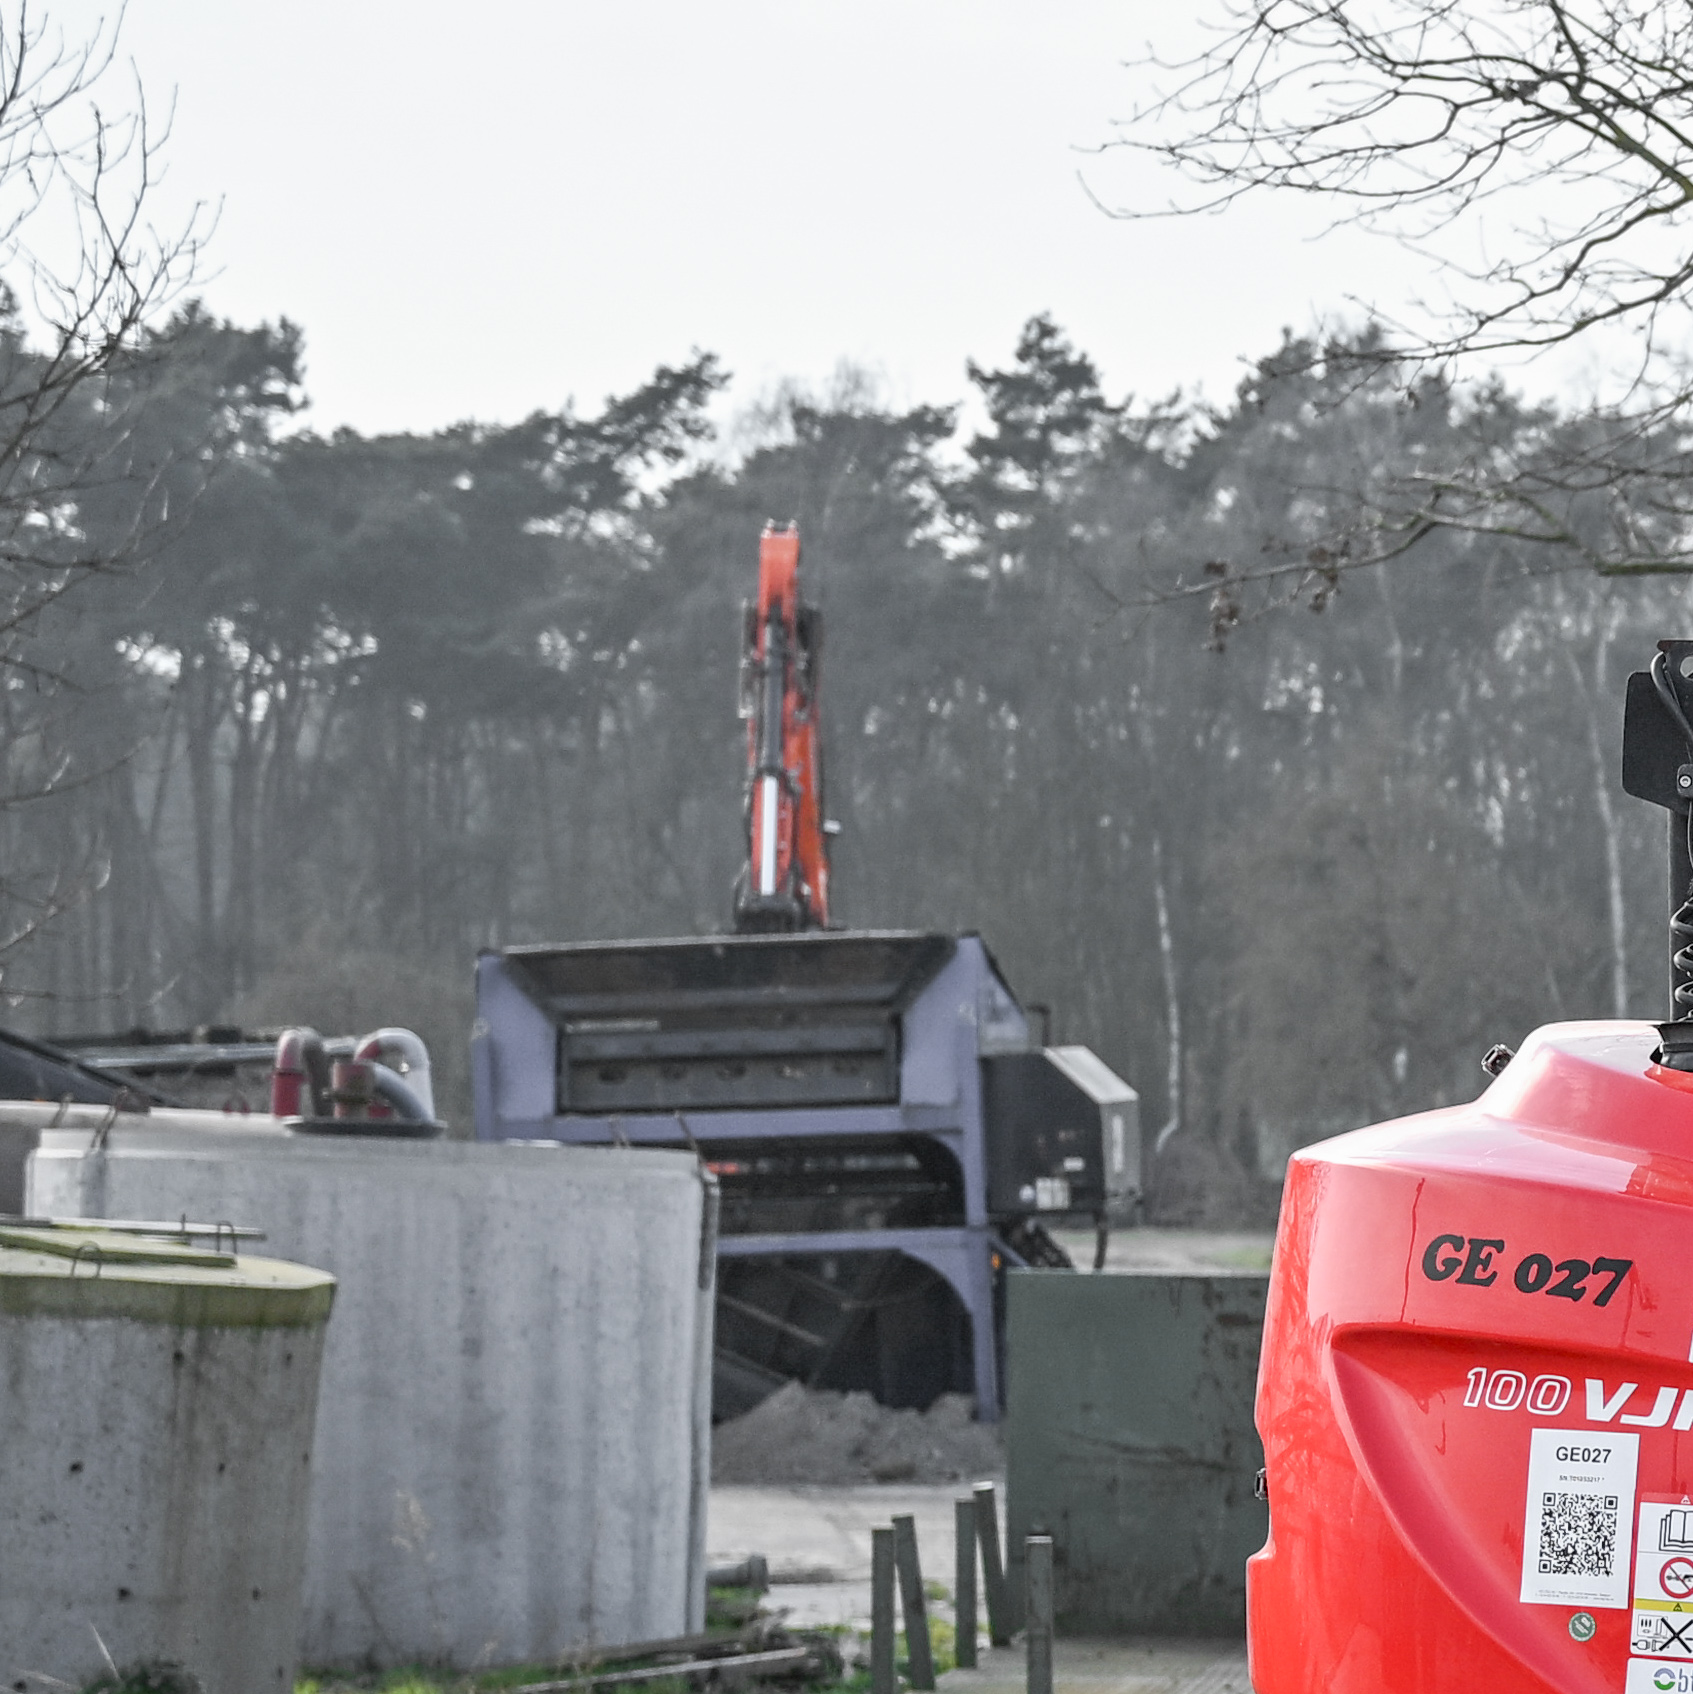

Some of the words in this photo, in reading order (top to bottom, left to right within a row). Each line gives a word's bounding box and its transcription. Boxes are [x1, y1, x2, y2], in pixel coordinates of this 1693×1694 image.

[1422, 1234, 1505, 1287] GE
[1514, 1253, 1634, 1307] 027
[1463, 1367, 1572, 1416] 100
[1556, 1446, 1612, 1464] GE027
